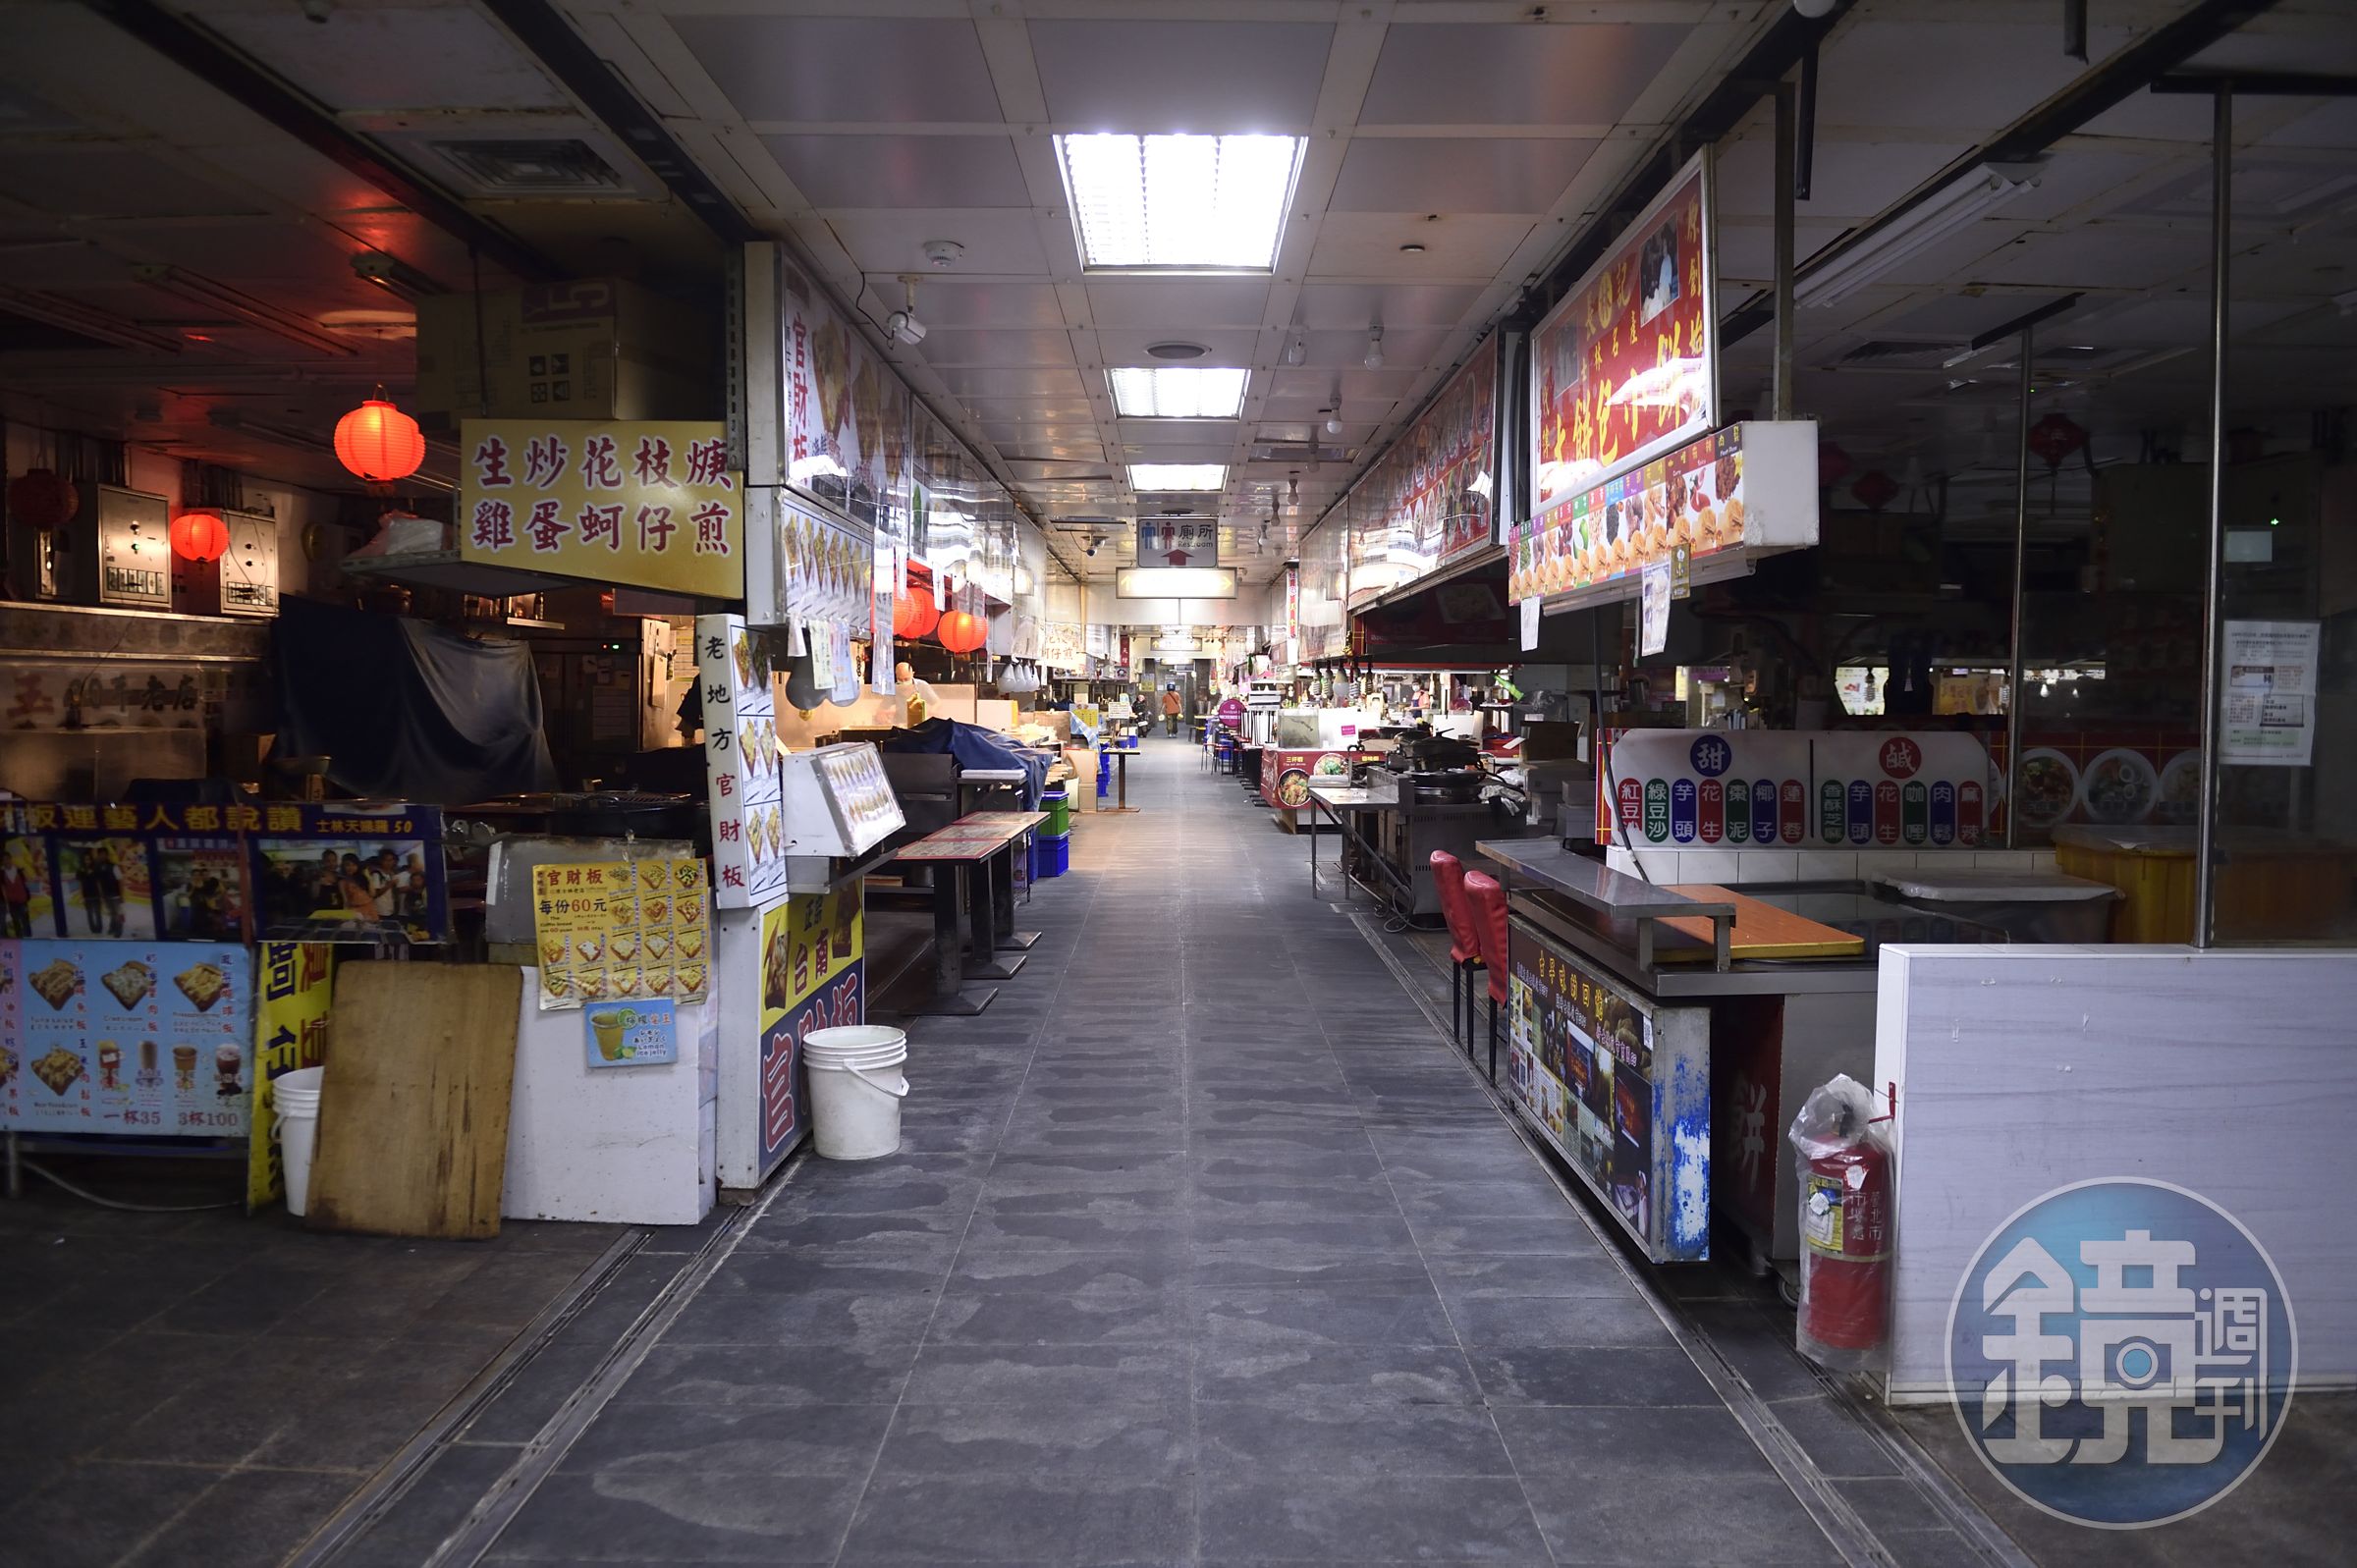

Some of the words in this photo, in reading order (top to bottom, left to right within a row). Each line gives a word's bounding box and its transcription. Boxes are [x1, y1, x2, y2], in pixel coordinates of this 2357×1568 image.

[473, 501, 729, 555] 雞蛋蚵仔煎
[1178, 524, 1213, 540] 廁所
[705, 636, 745, 889] 老地方官財板
[1696, 742, 1726, 771] 甜
[1886, 741, 1916, 773] 鹹
[394, 820, 413, 833] 50
[1648, 784, 1668, 838] 綠豆沙
[1674, 784, 1694, 838] 芋頭
[1701, 784, 1721, 838] 花生
[1755, 784, 1775, 838] 椰子
[1850, 785, 1870, 840] 芋頭
[1878, 786, 1897, 840] 花生
[1905, 786, 1925, 840] 咖哩
[1933, 786, 1951, 840] 肉鬆
[1960, 786, 1980, 842] 麻辣
[547, 869, 603, 886] 官財板
[539, 897, 607, 915] 每份60元
[795, 928, 828, 996] 台南
[104, 1109, 160, 1125] 一杯35
[179, 1111, 238, 1126] 3杯100
